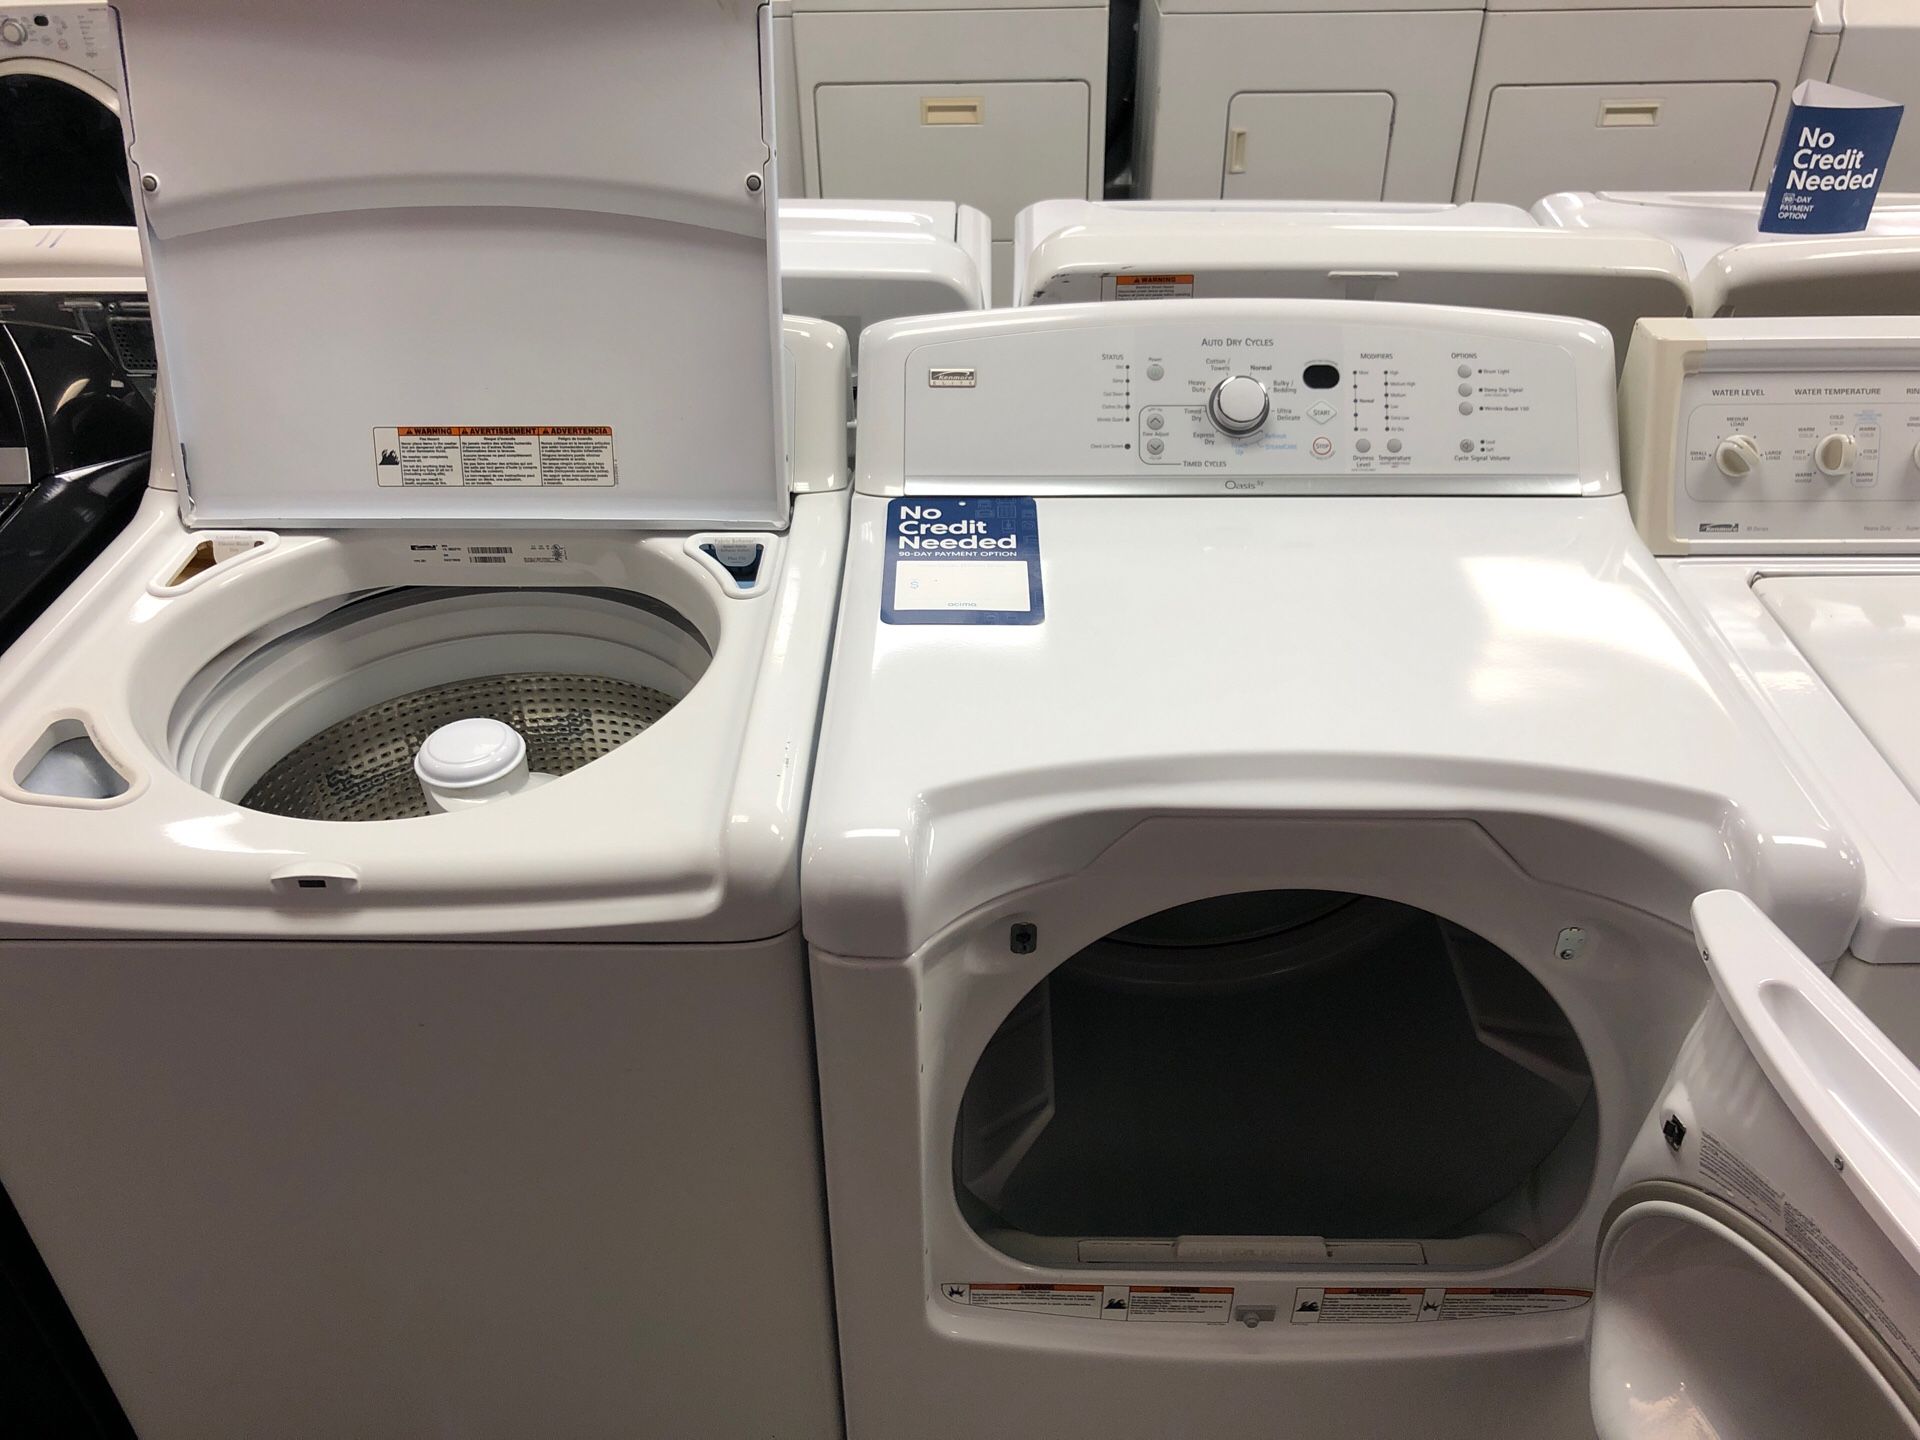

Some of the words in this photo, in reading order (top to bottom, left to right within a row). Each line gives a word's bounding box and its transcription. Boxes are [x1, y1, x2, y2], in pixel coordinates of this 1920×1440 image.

[1799, 127, 1835, 148] No
[1793, 149, 1864, 170] Credit
[1786, 168, 1878, 191] Needed
[1780, 204, 1814, 212] PAYMENT
[1778, 212, 1807, 220] OPTION
[1201, 338, 1223, 346] AUTO
[1226, 338, 1242, 346] DRY
[1245, 338, 1274, 346] CYCLES
[1225, 480, 1255, 489] Oasis
[900, 506, 942, 519] No
[899, 520, 987, 535] Credit
[899, 534, 1017, 549] Needed
